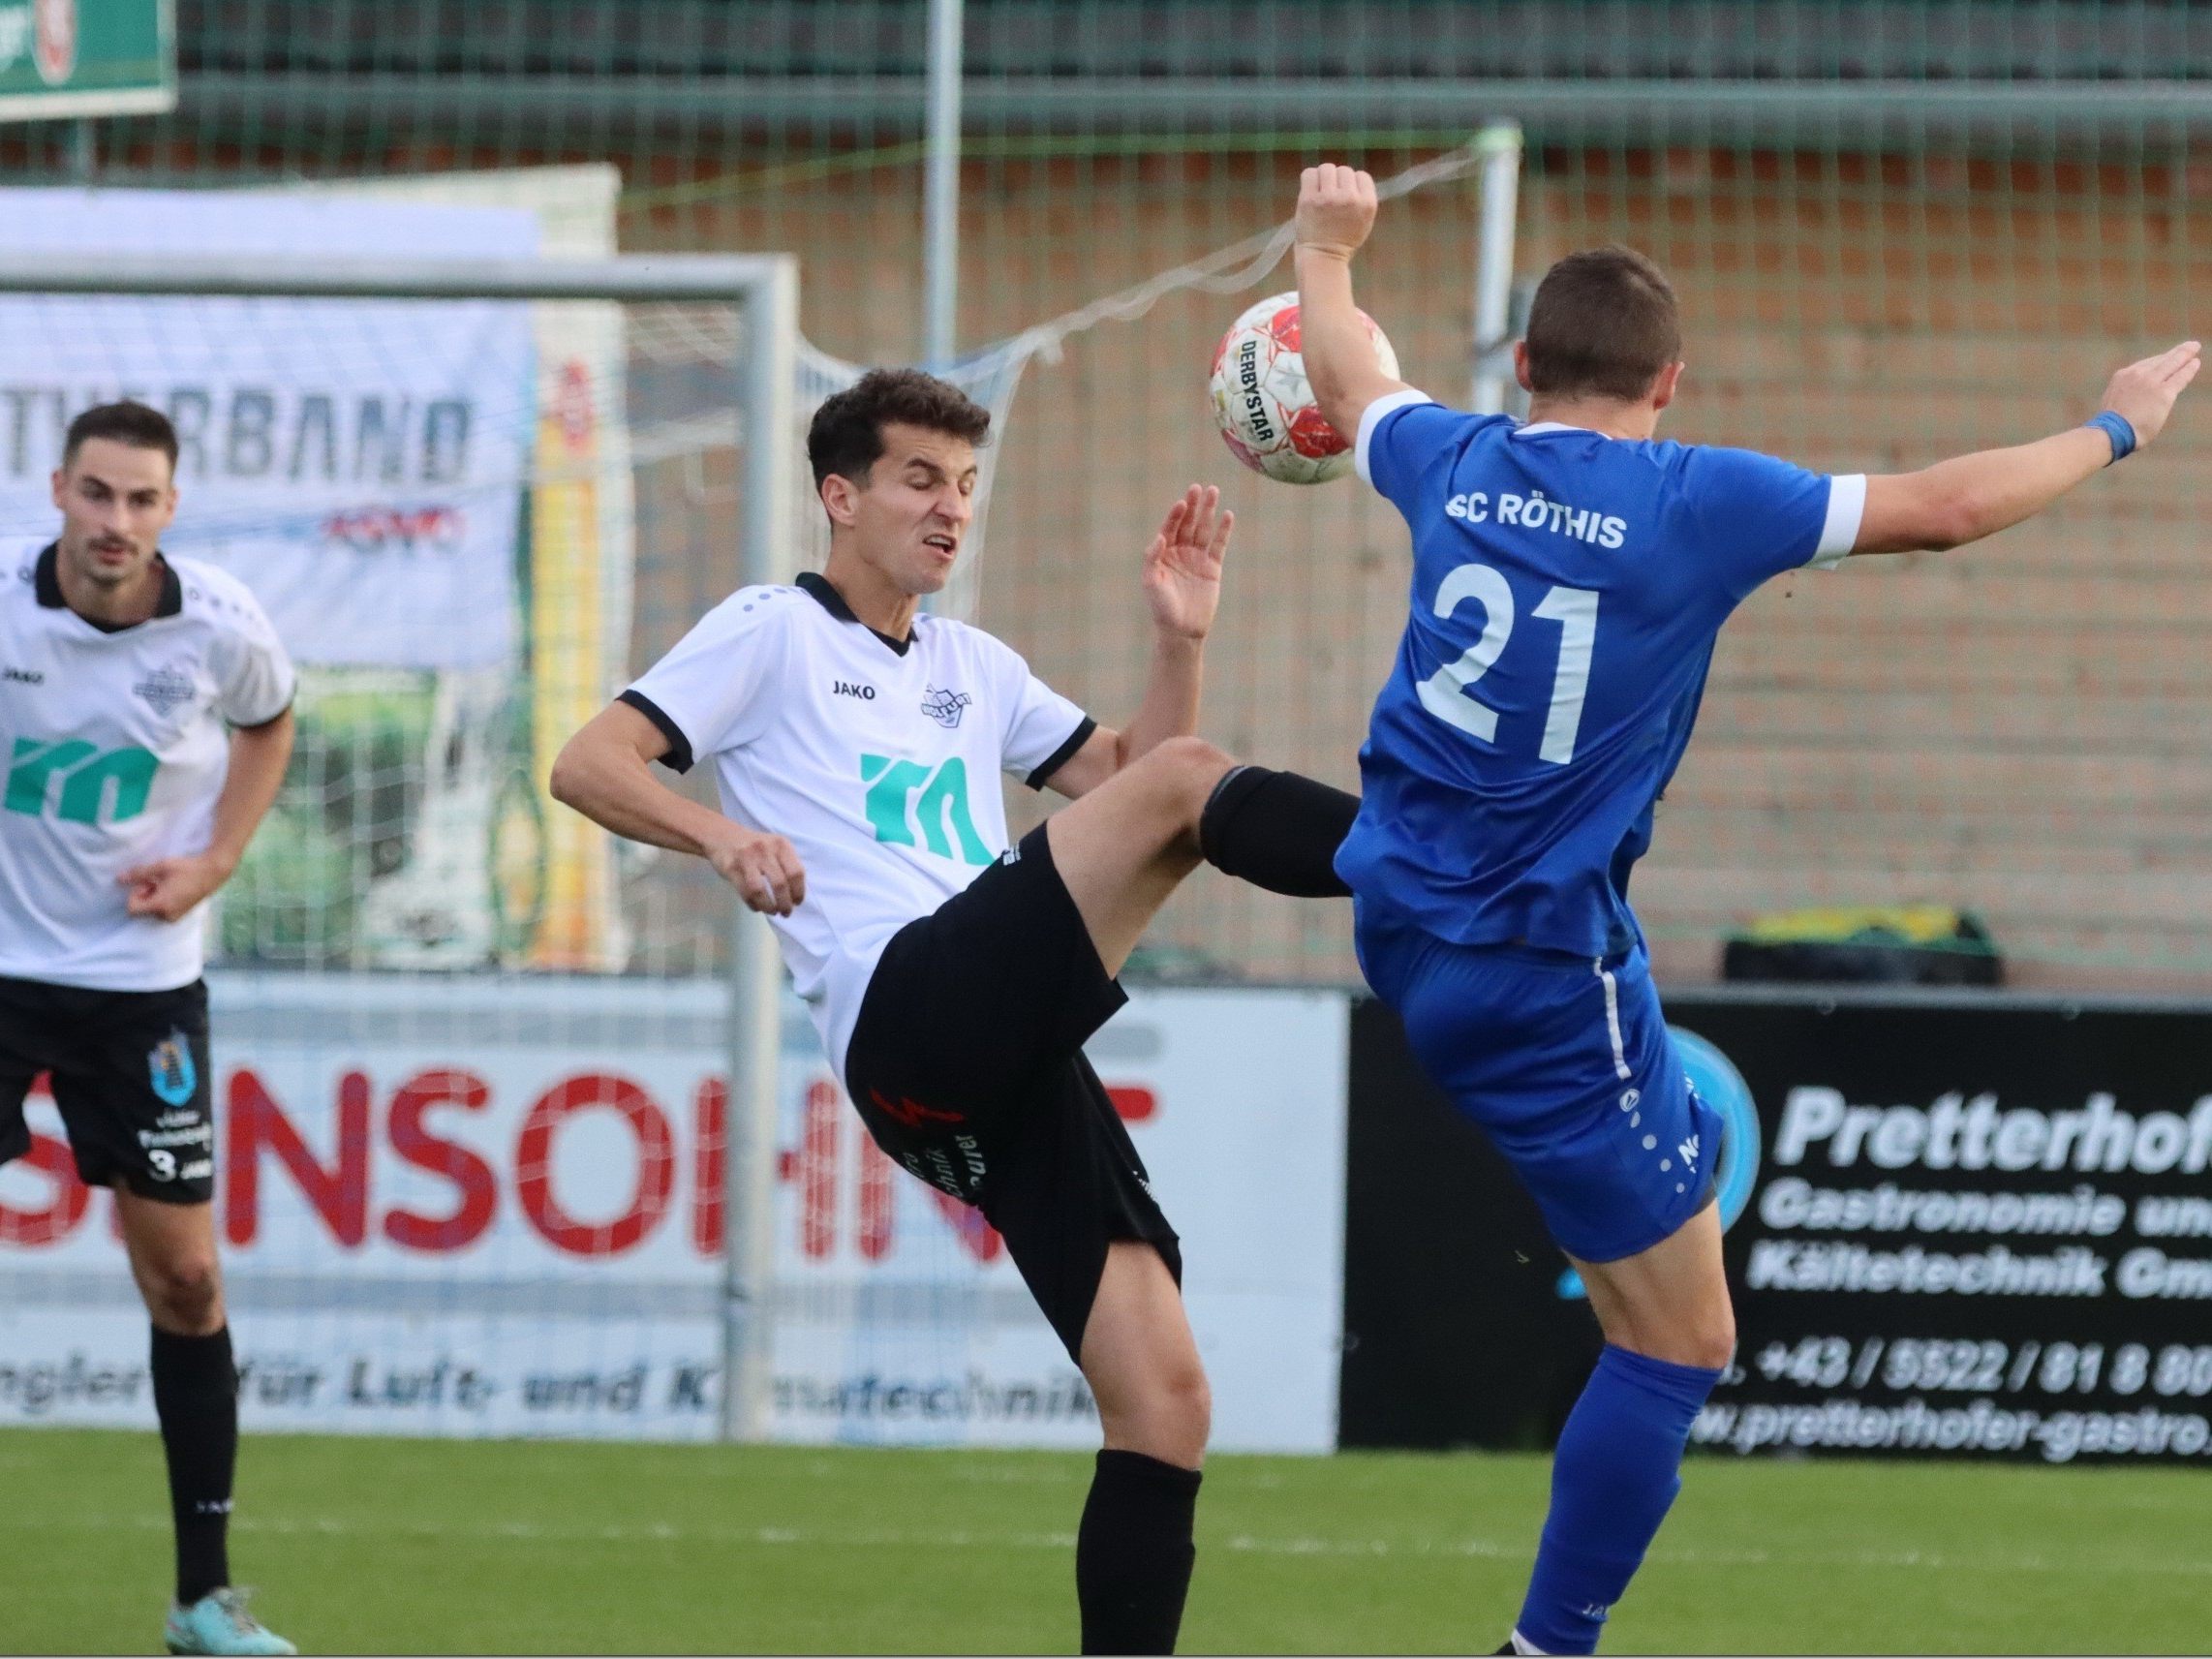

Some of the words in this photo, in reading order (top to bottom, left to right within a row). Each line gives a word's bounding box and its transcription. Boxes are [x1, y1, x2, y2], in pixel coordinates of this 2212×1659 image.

[1241, 340, 1275, 442] DERBYSTAR
[1445, 492, 1489, 523] SC
[1497, 490, 1627, 548] RÖTHIS
[833, 680, 876, 700] JAKO
[1415, 563, 1601, 765] 21
[149, 1150, 175, 1182] 3
[1759, 1177, 2127, 1237] Gastronomie
[1746, 1240, 2108, 1298] Kältetechnik
[522, 1359, 647, 1414] und
[1755, 1336, 1852, 1388] +43
[1849, 1336, 1887, 1390] /
[1882, 1338, 2011, 1391] 5522
[2006, 1340, 2043, 1394] /
[2038, 1341, 2104, 1395] 81
[2108, 1342, 2151, 1395] 8
